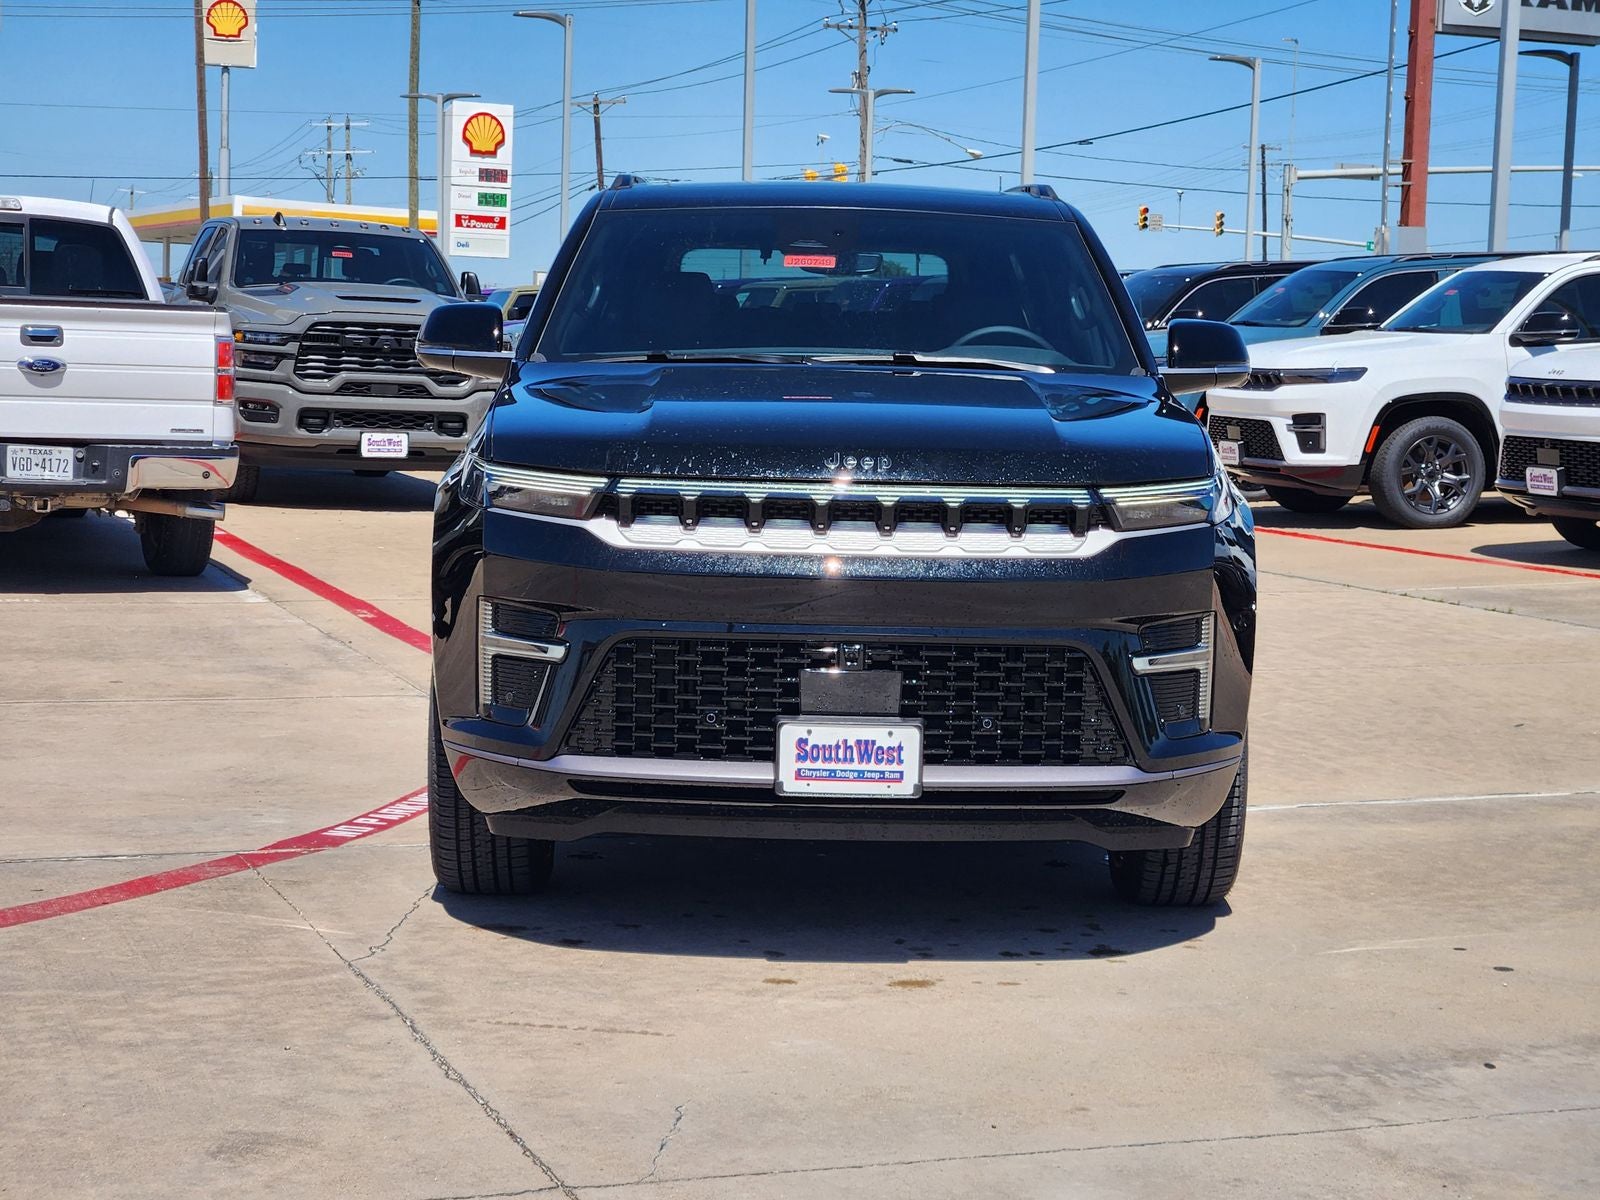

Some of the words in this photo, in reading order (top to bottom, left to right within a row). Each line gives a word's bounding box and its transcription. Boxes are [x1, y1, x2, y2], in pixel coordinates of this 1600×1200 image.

[460, 219, 499, 229] V-Power
[456, 241, 470, 249] Deli
[28, 448, 53, 456] TEXAS
[823, 452, 892, 473] Jeep
[794, 736, 904, 766] SouthWest
[800, 769, 830, 778] Chrysler
[835, 770, 858, 779] Dodge
[863, 770, 880, 780] Jeep
[884, 771, 900, 779] Ram
[320, 825, 375, 837] NO
